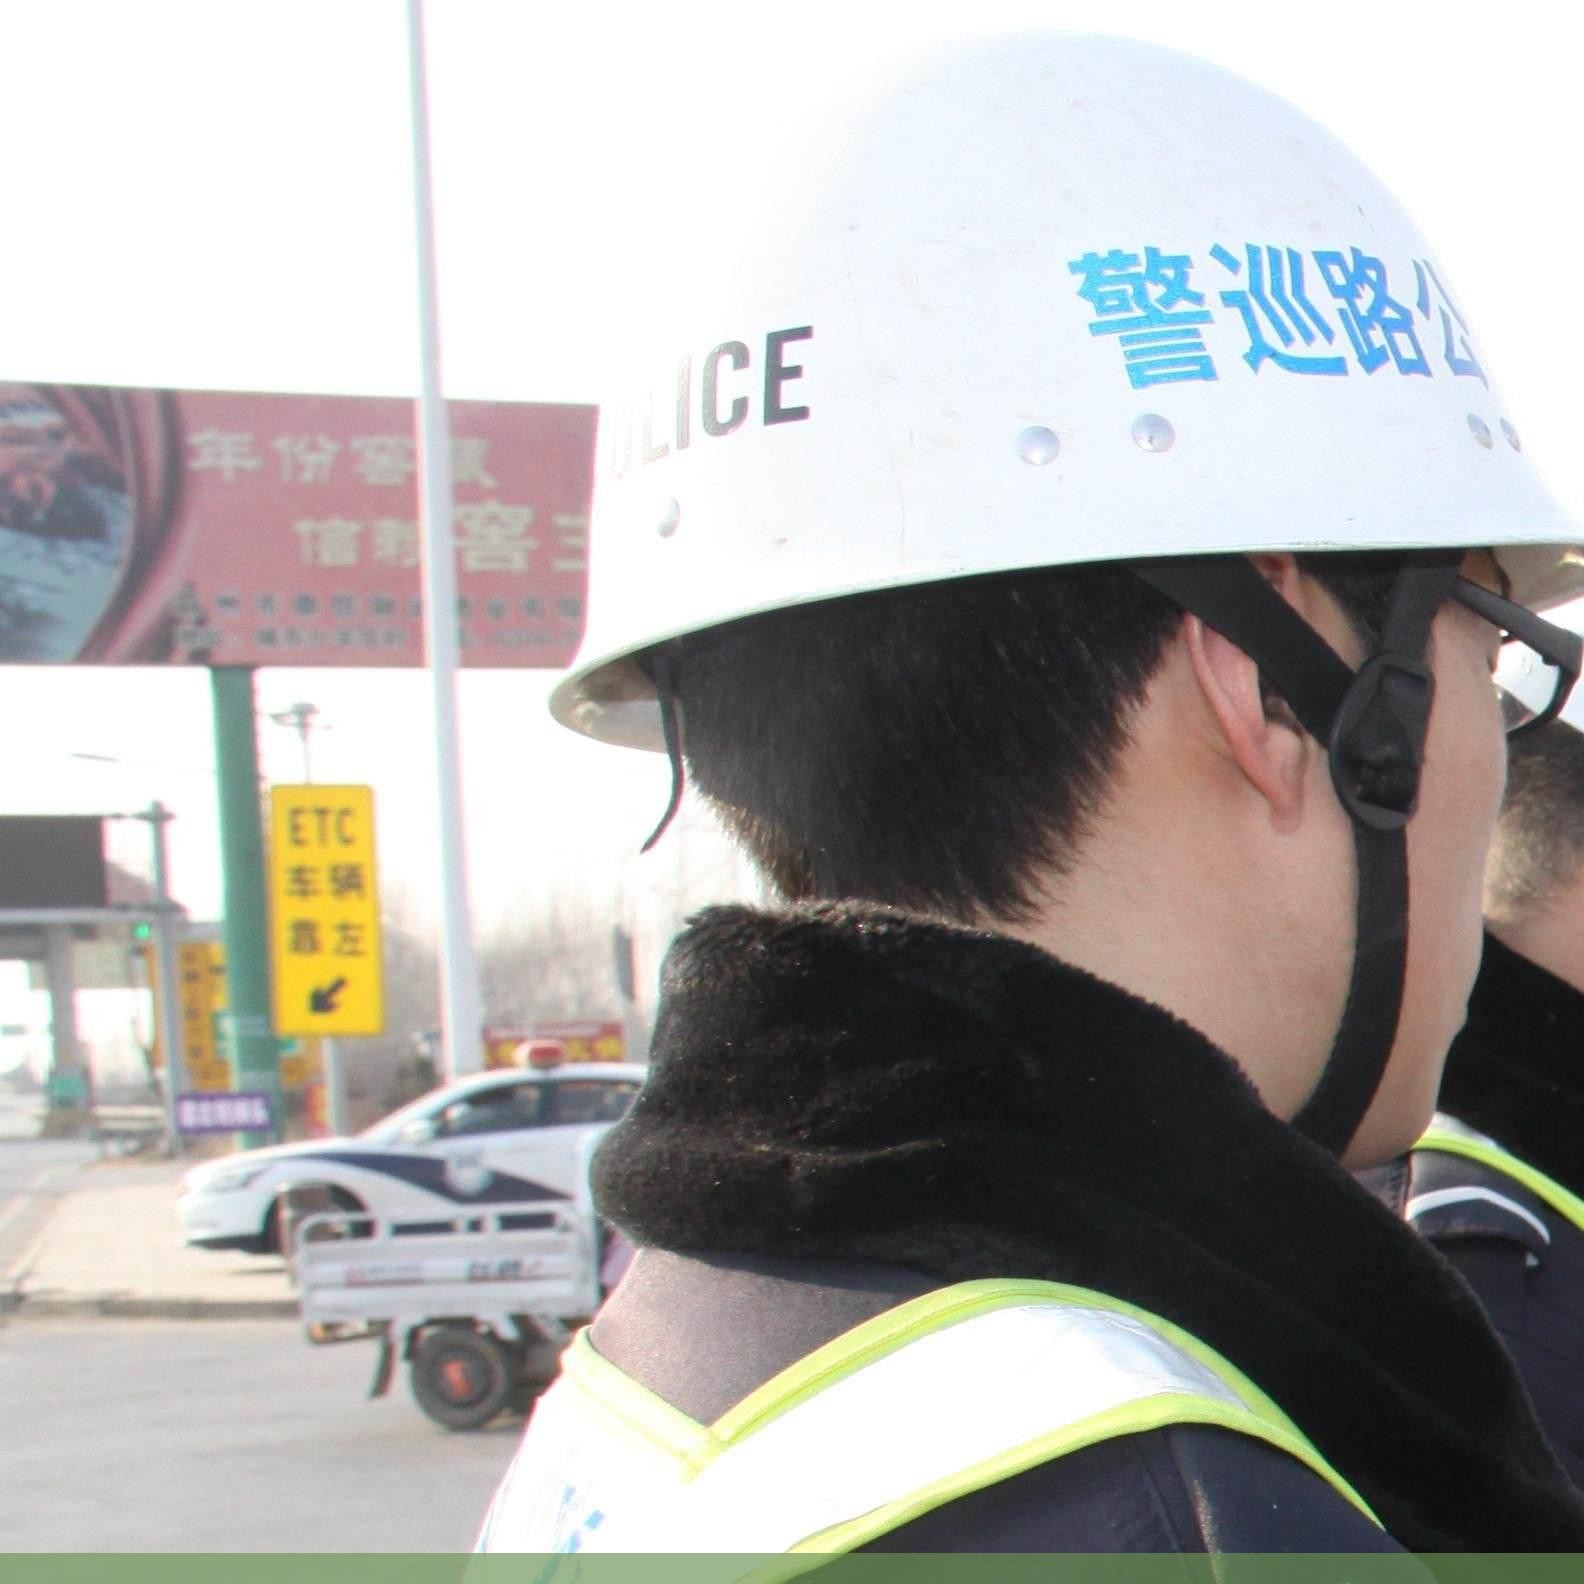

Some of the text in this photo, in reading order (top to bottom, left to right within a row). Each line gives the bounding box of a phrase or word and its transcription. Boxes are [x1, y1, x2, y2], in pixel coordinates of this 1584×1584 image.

[1068, 242, 1489, 391] 警巡路公
[288, 807, 356, 847] ETC
[285, 863, 366, 900] 车辆
[288, 918, 365, 956] 靠左
